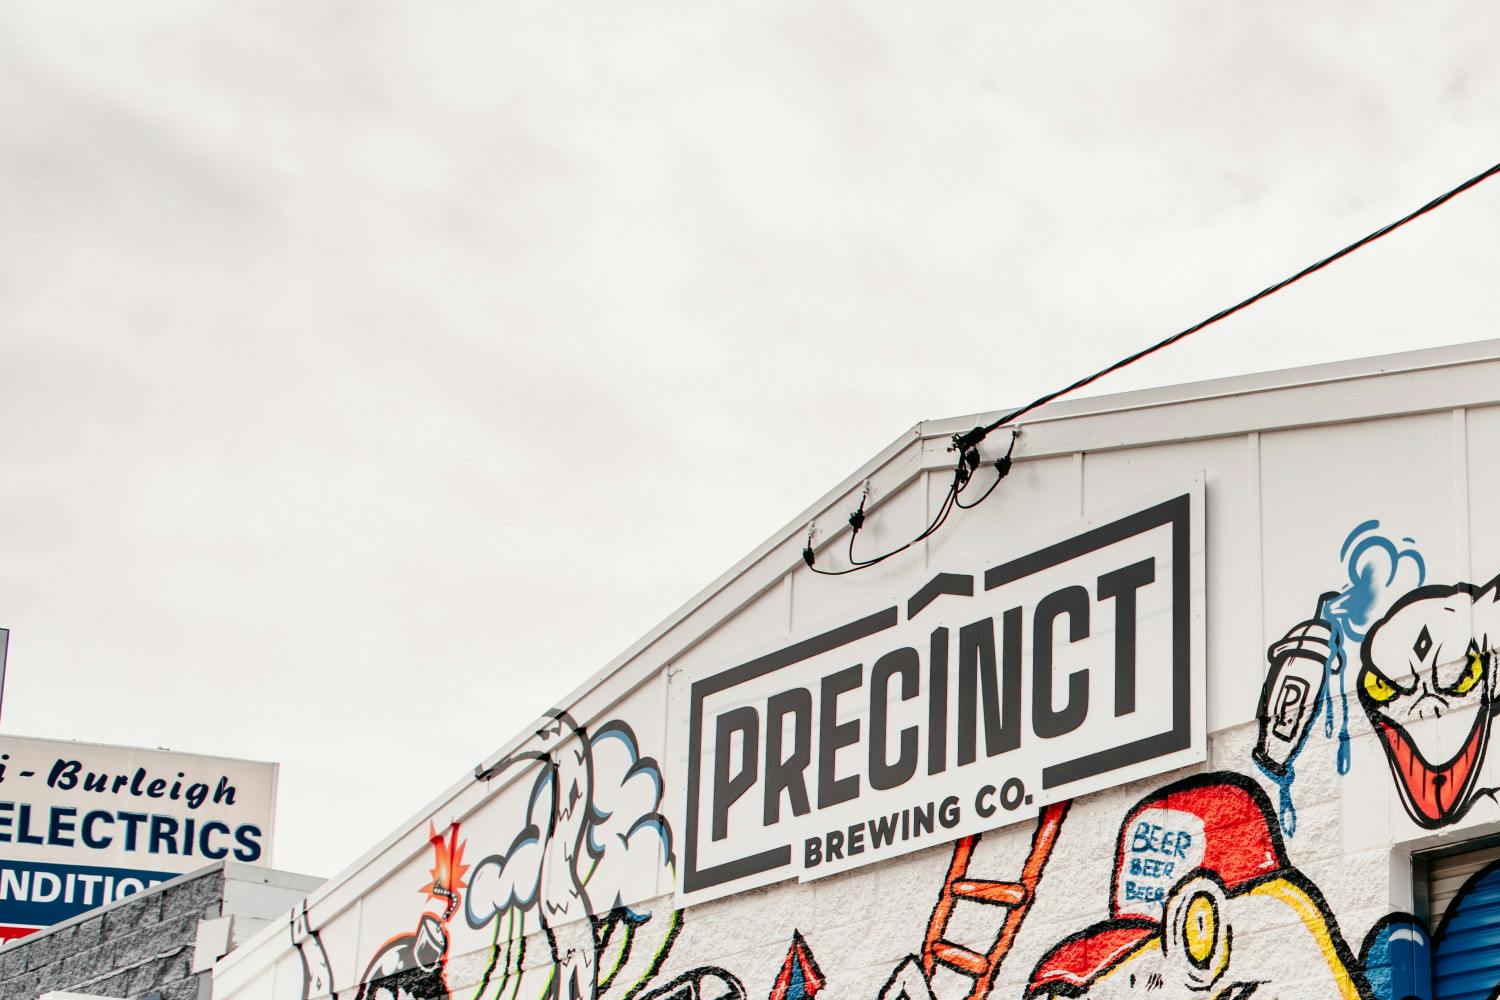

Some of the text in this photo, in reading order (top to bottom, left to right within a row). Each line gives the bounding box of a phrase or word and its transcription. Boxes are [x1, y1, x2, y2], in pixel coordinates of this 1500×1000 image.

[711, 556, 1155, 842] PRECINCT
[47, 758, 236, 809] Burleigh
[804, 776, 1034, 869] BREWING CO.
[1131, 821, 1192, 860] BEER
[0, 868, 161, 906] NDITIO
[1129, 856, 1176, 879] BEER
[1125, 878, 1166, 904] BEER
